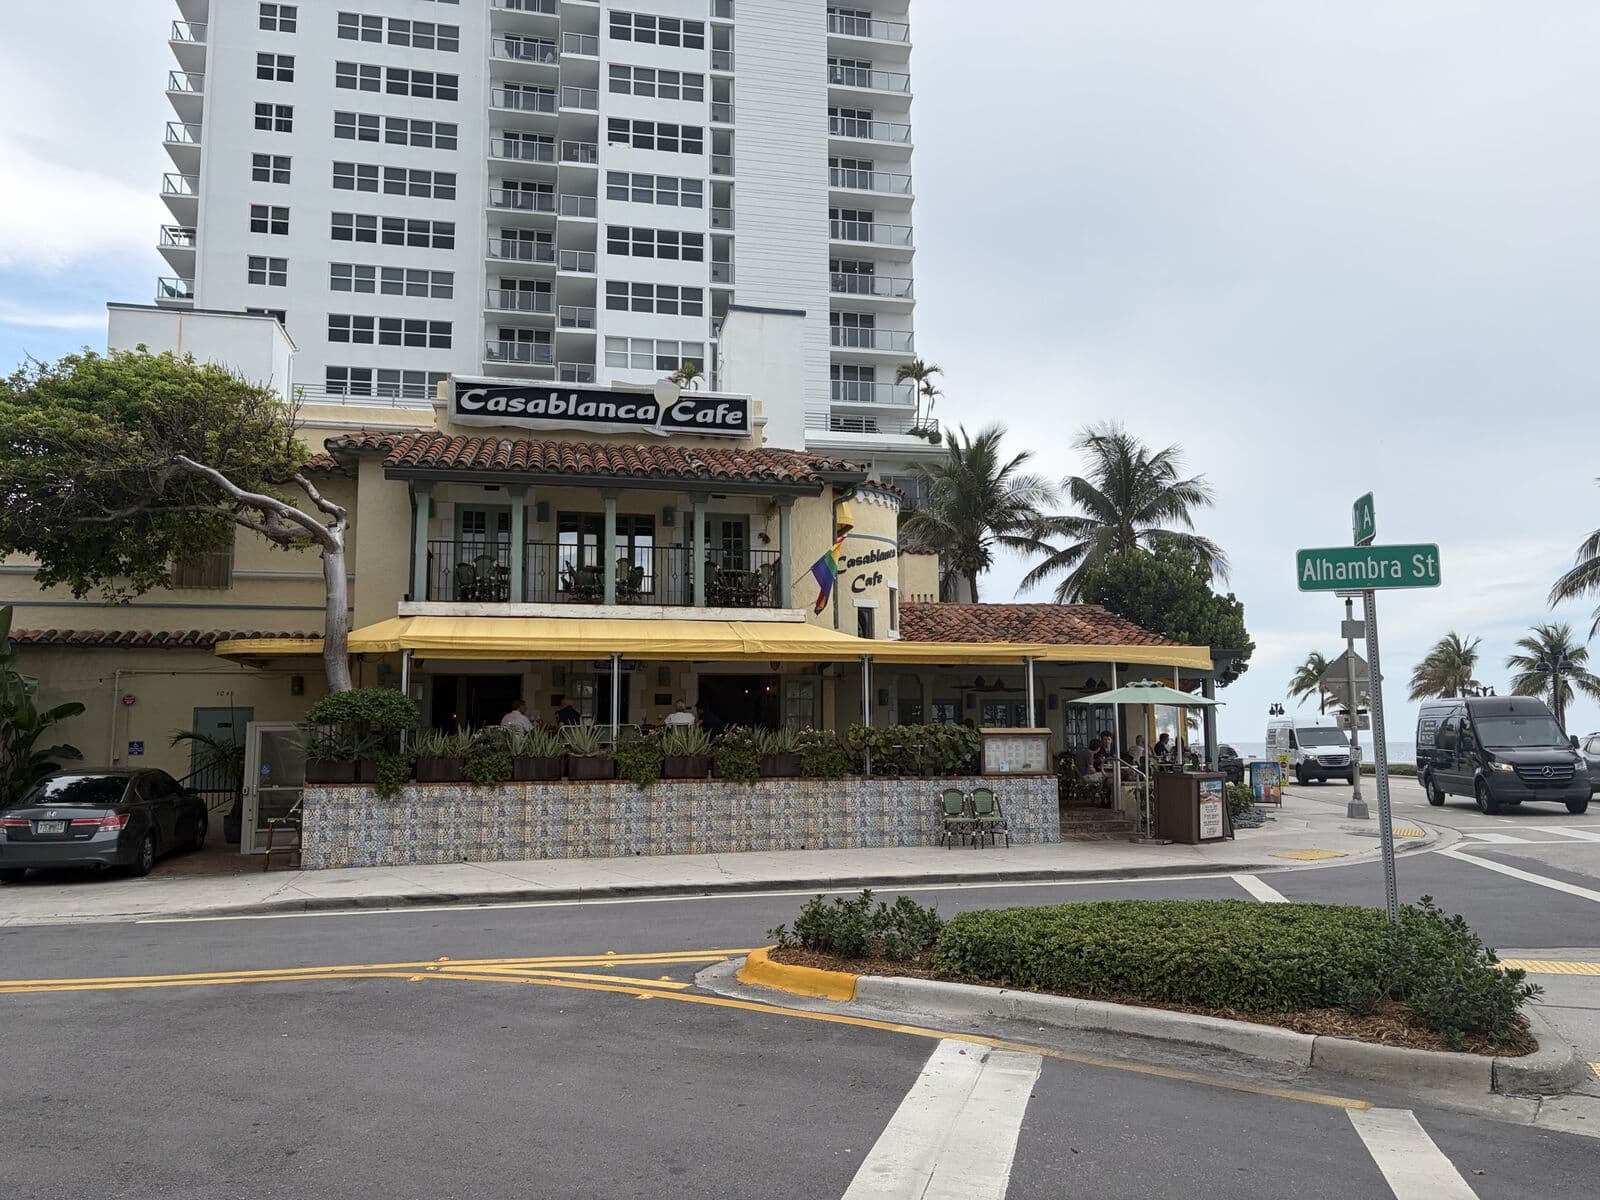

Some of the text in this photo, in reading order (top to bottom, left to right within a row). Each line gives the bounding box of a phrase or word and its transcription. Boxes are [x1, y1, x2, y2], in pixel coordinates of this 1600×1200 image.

[459, 389, 743, 425] Casablanca Cafe
[851, 571, 883, 593] Cafe
[1302, 553, 1435, 582] Alhambra St
